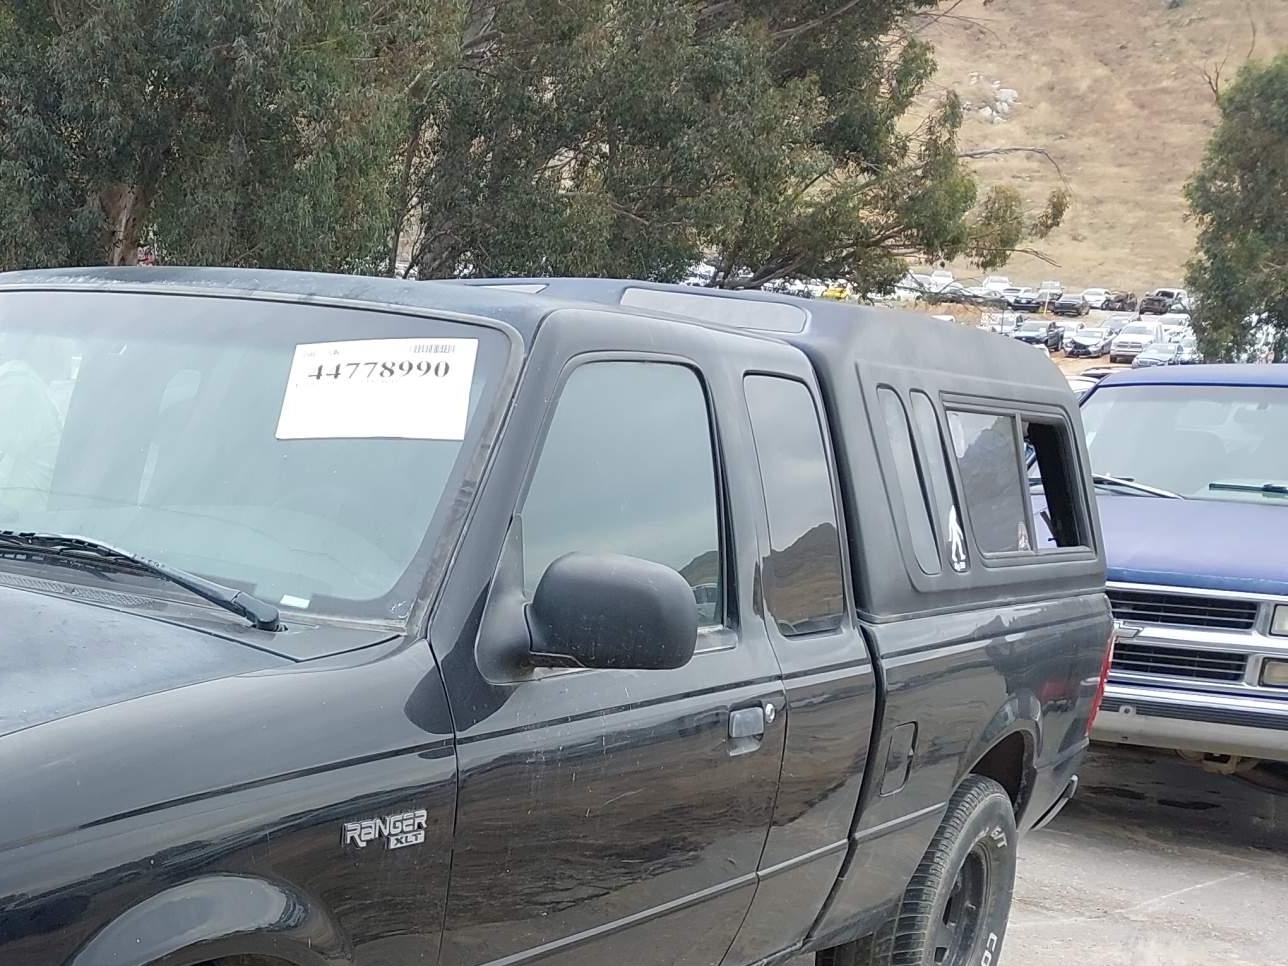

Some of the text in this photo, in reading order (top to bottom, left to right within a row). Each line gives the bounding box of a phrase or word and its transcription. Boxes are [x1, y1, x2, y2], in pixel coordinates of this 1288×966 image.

[307, 359, 451, 380] 44778990
[344, 809, 428, 848] RANGER
[390, 829, 424, 848] XLT
